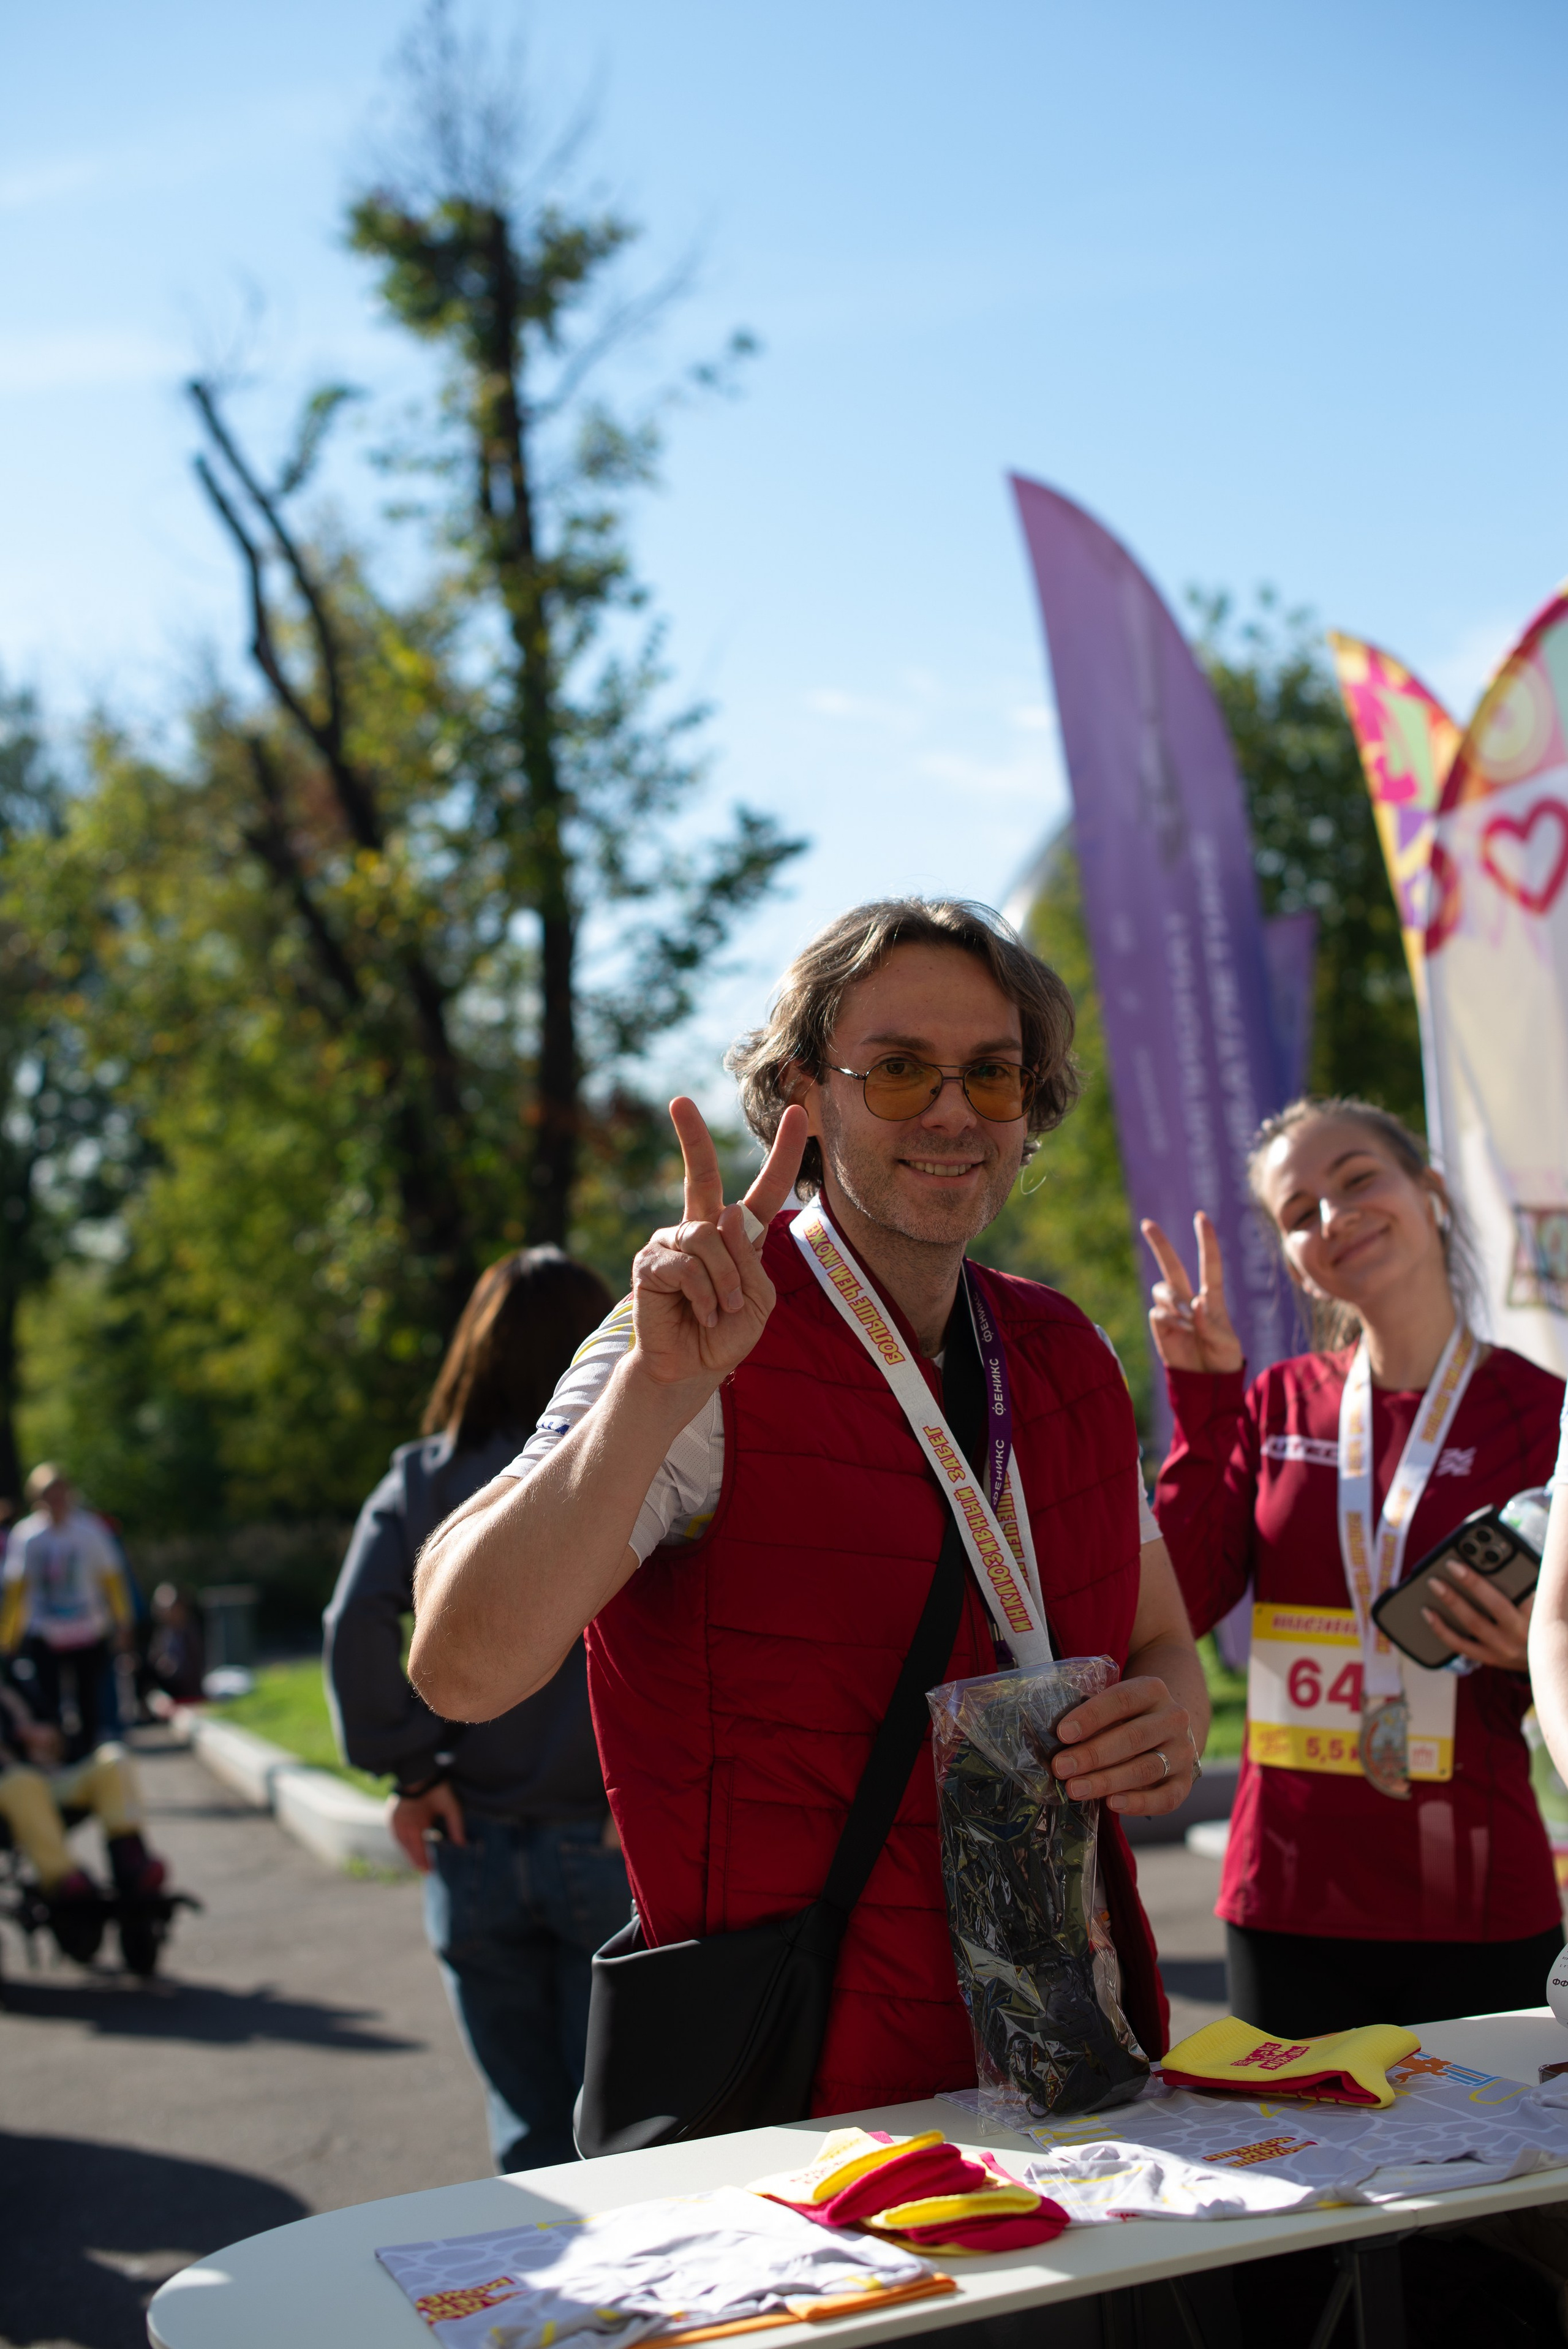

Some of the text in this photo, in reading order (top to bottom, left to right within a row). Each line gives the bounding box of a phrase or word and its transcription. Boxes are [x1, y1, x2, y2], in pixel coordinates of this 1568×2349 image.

[803, 1218, 906, 1365] БОЛЬШЕ ЧЕМ МОЖЕ
[973, 1291, 993, 1343] ФЕНИКС
[989, 1358, 1006, 1416] ФЕНИКС
[922, 1425, 966, 1483] ЗАБЕГ
[993, 1439, 1005, 1506] ФЕНИКС
[954, 1485, 1034, 1633] ИНКЛЮЗИВНЫЙ
[1288, 1657, 1365, 1713] 64
